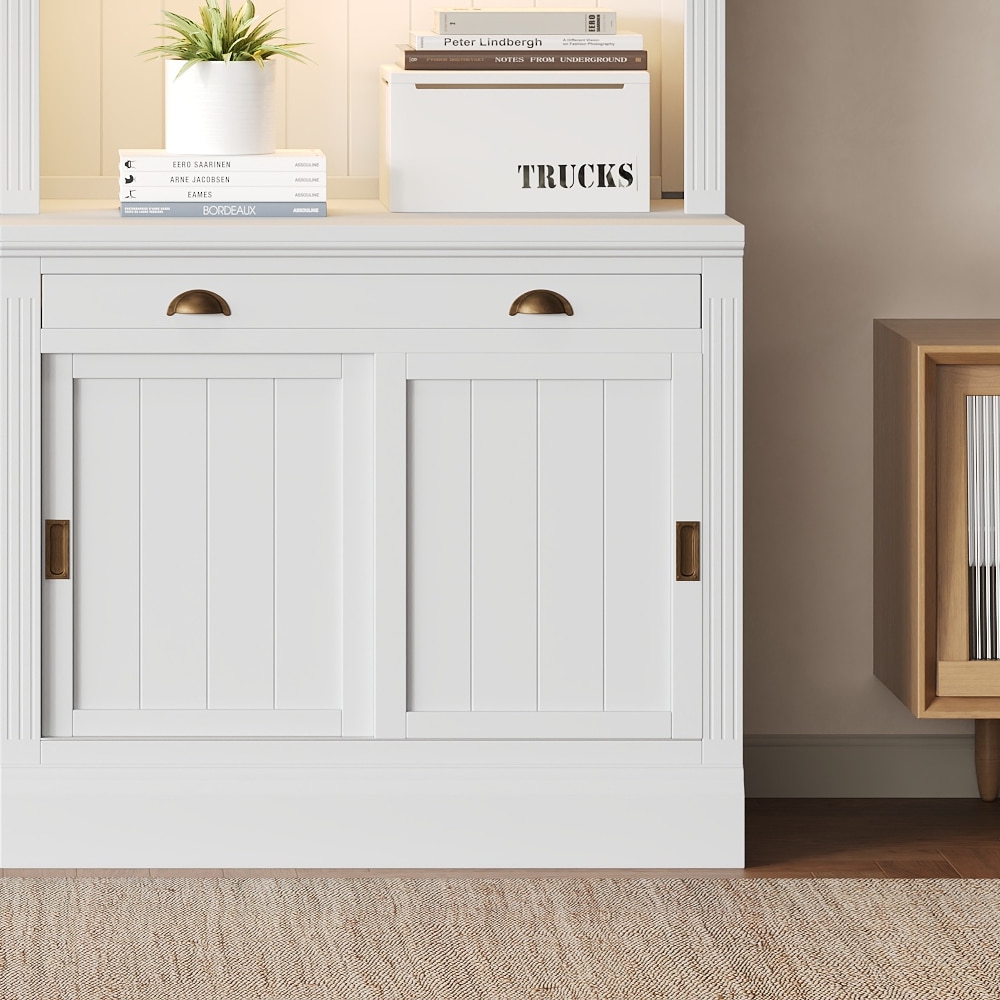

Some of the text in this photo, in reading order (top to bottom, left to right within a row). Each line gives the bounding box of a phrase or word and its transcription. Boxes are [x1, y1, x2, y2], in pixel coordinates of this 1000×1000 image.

[444, 38, 542, 49] Peter Lindbergh
[517, 162, 634, 189] TRUCKS
[203, 205, 256, 216] BORDEAUX
